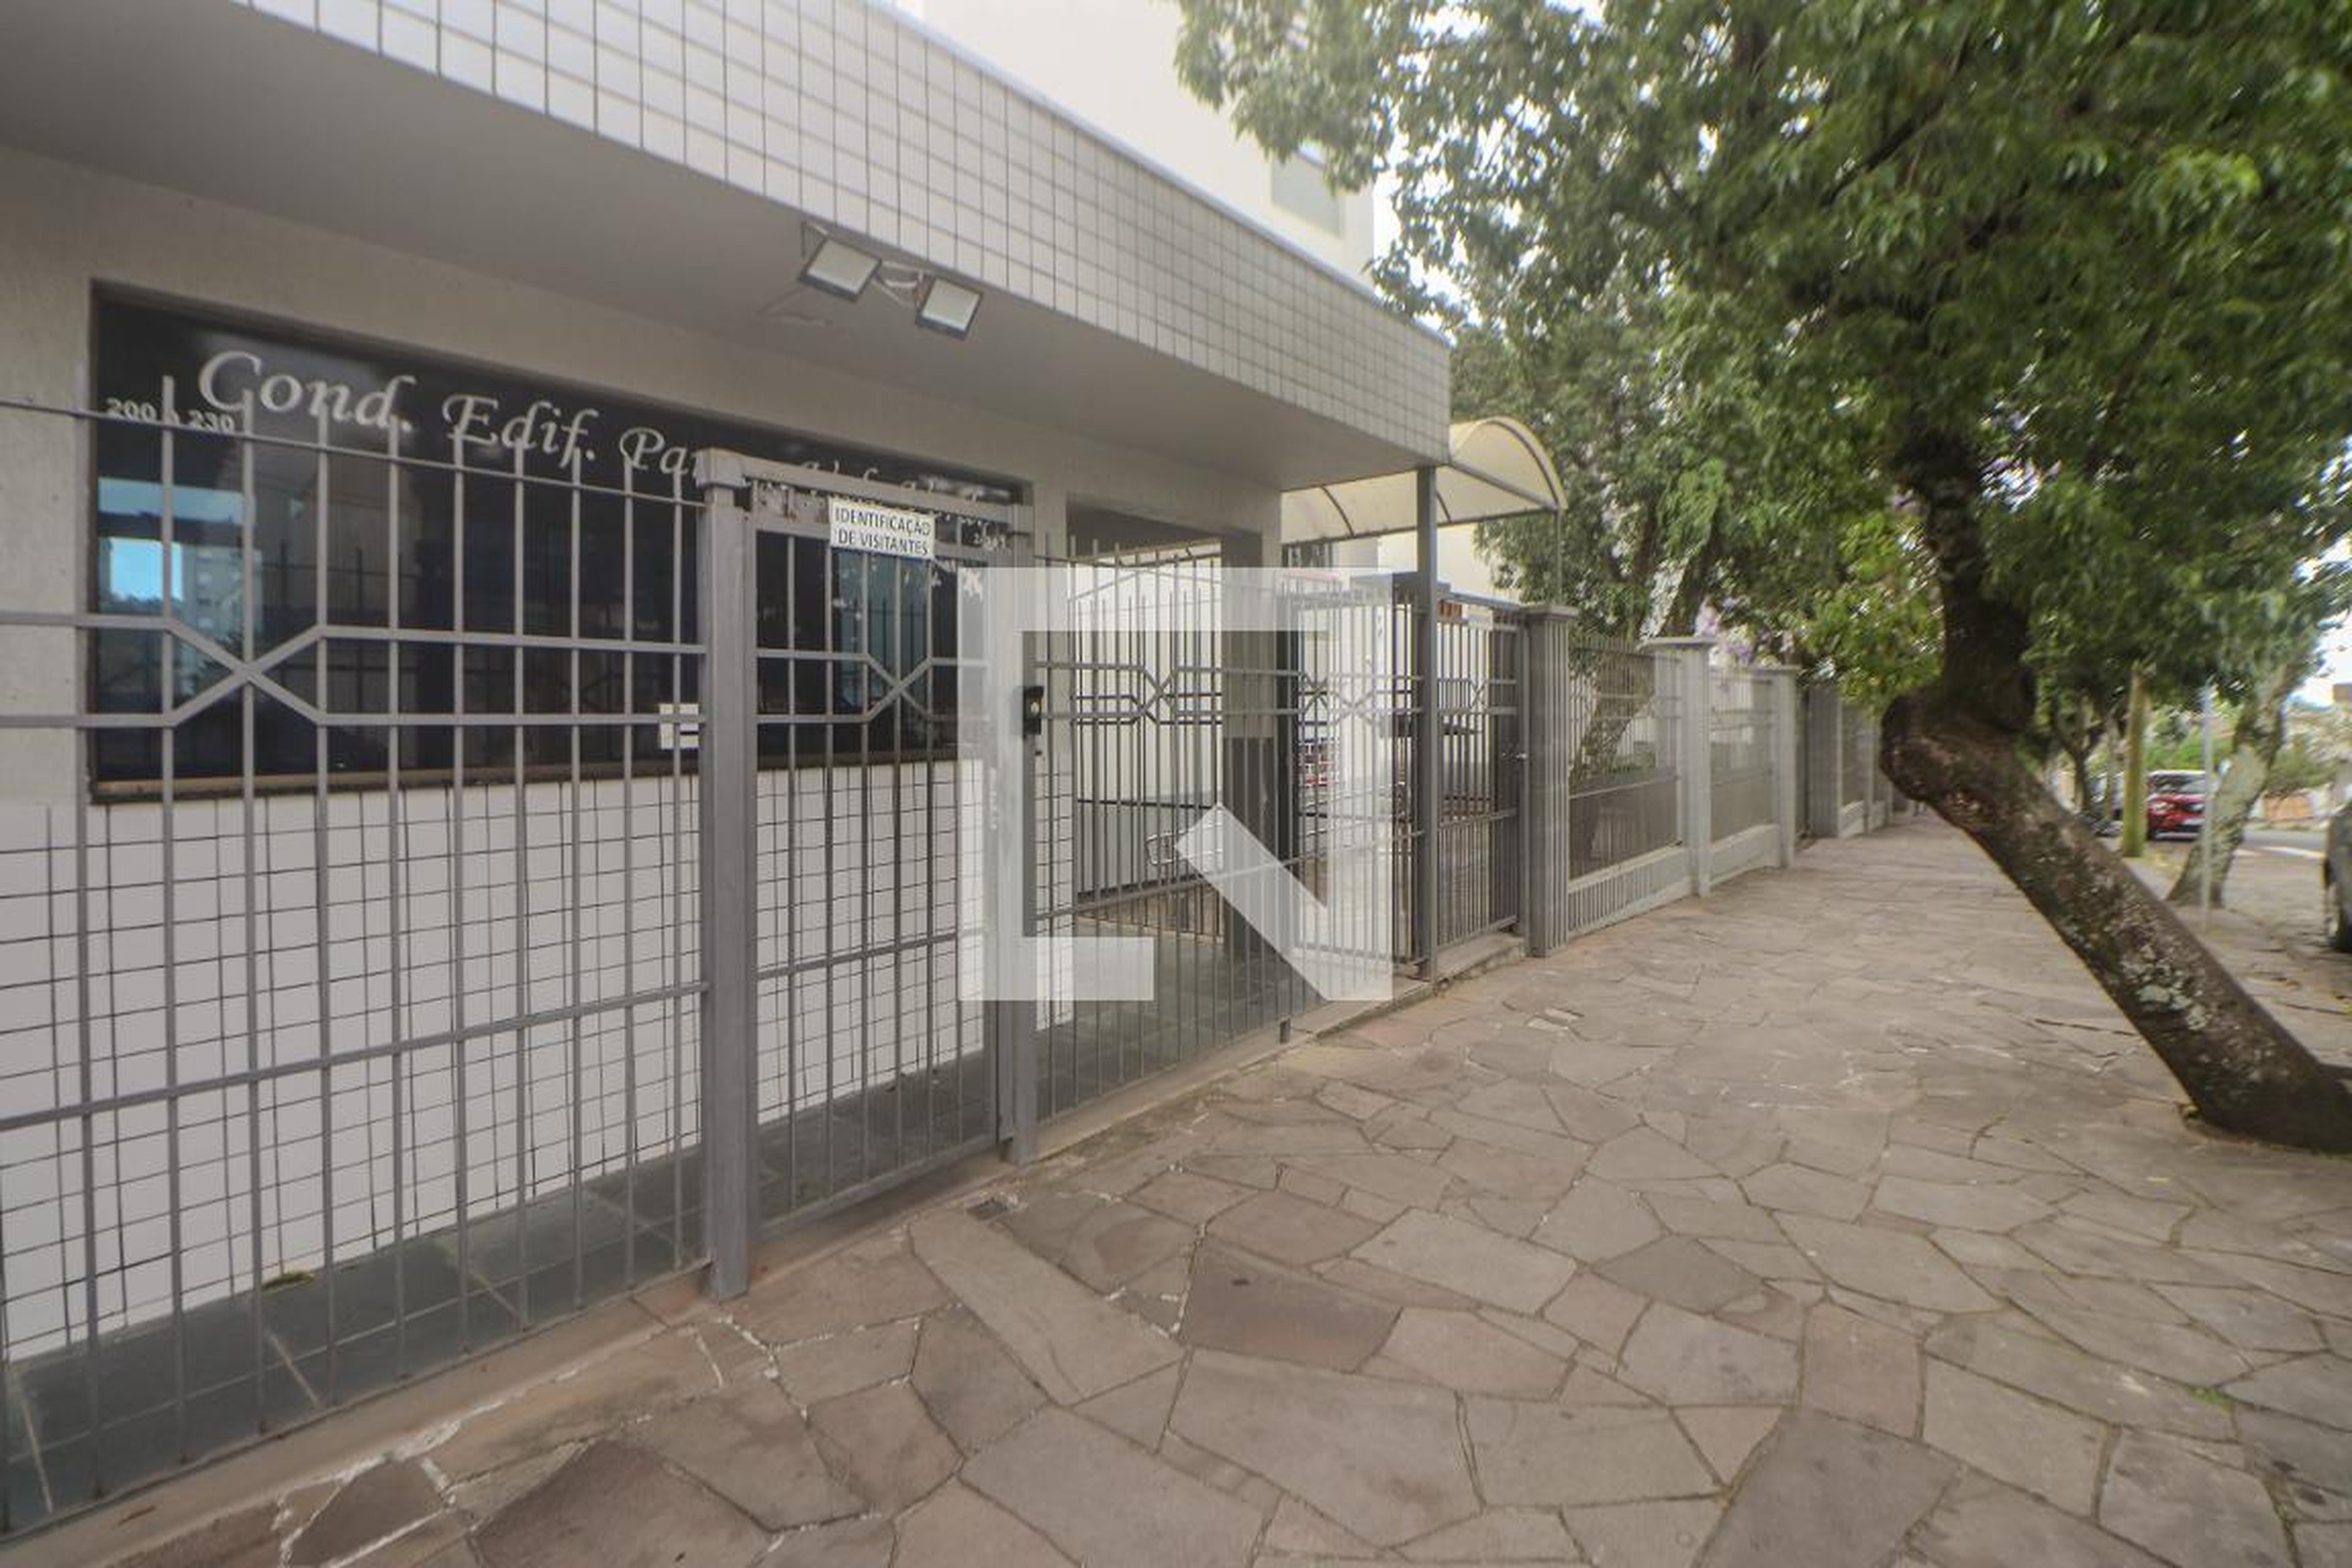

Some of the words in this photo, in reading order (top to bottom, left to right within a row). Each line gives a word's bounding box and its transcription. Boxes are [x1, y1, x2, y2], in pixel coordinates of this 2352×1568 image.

[198, 350, 416, 432] Cond.
[442, 394, 599, 469] Edif.
[839, 527, 856, 545] DE
[860, 532, 929, 556] VISITANTES
